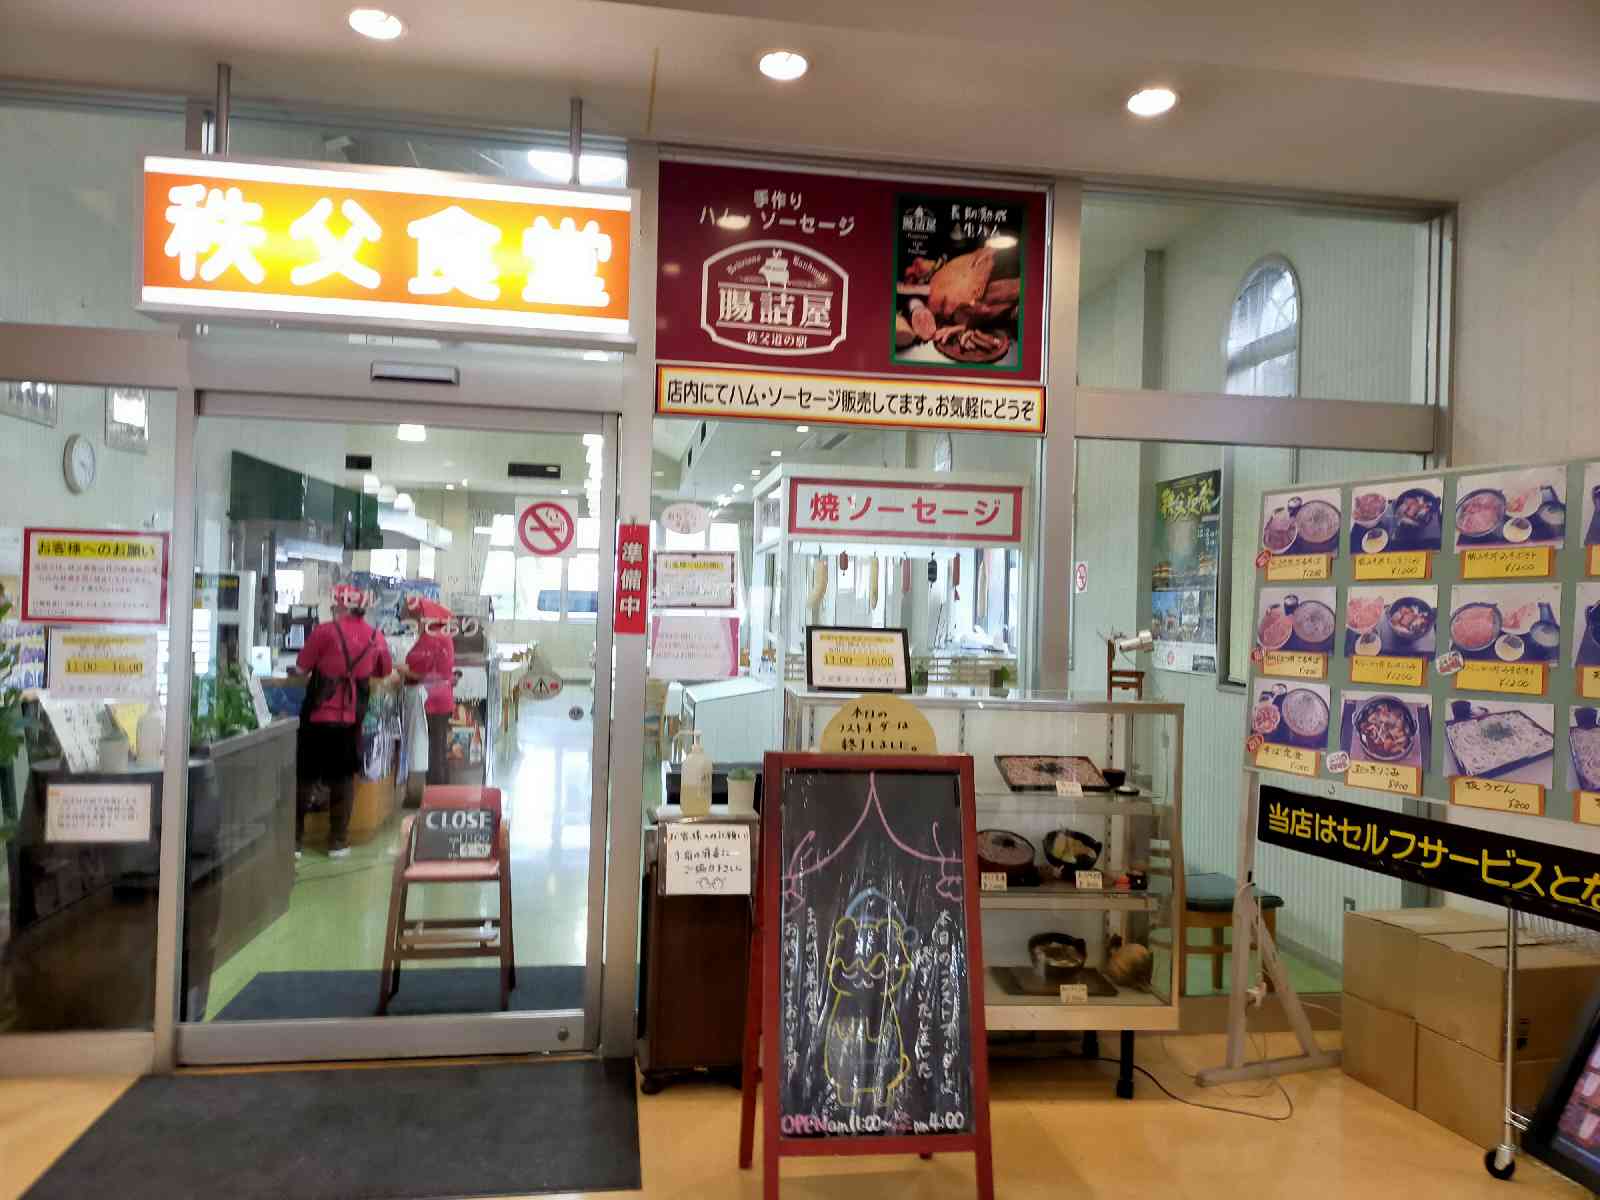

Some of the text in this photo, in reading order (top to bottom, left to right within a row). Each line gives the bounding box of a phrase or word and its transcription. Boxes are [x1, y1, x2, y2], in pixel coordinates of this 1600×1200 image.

[753, 188, 802, 211] 手作り
[164, 183, 613, 308] 秩父食堂
[718, 287, 832, 329] 腸詰屋
[667, 379, 1035, 422] 店内にてハム・ソーセージ販売してます。お気軽にどうぞ
[810, 491, 1001, 526] 焼ソーセージ
[37, 540, 156, 559] お客様へのお願い
[619, 541, 643, 621] 準備中
[425, 809, 492, 831] CLOSE
[781, 1113, 828, 1134] OPEN
